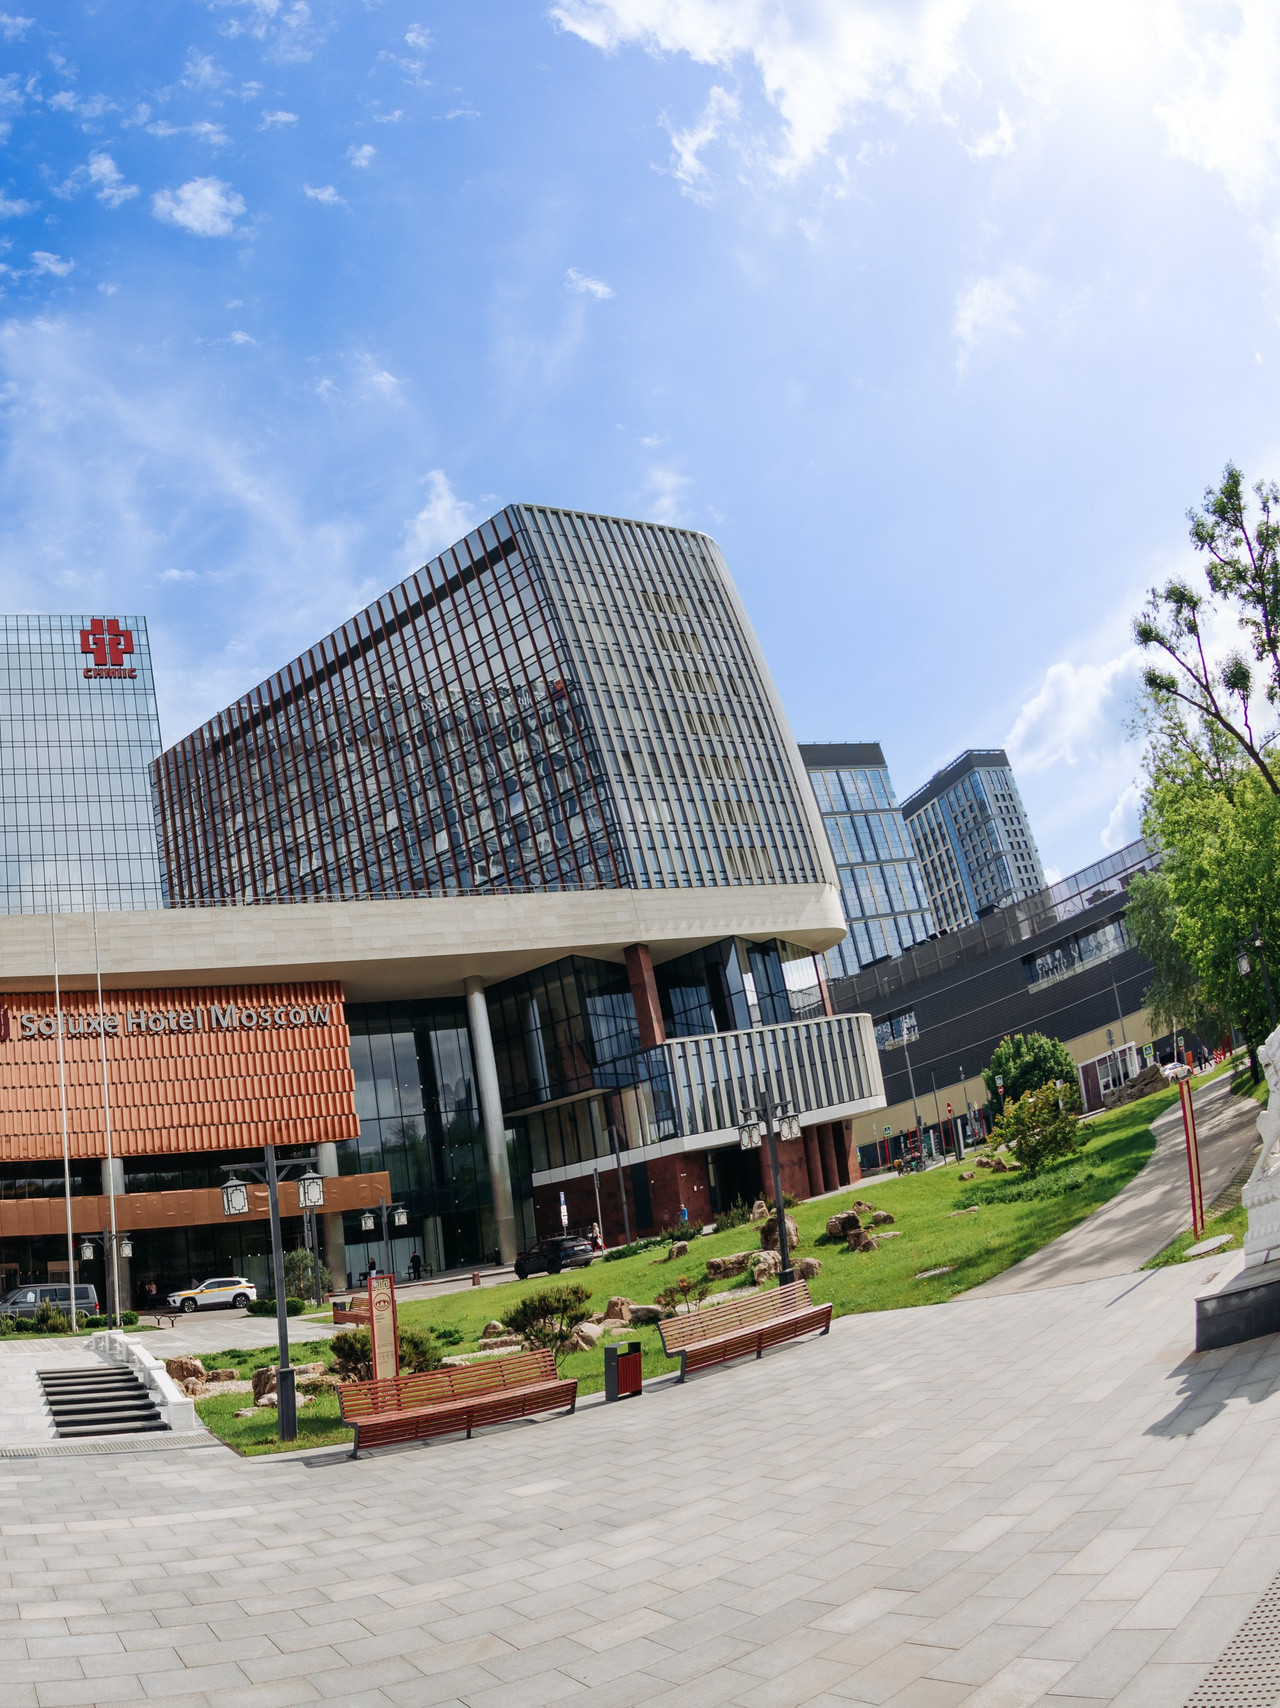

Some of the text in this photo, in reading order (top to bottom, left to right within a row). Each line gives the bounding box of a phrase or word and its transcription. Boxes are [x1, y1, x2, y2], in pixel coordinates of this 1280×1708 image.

[83, 668, 137, 679] CHMIIC
[21, 1004, 331, 1036] Soluxe Hotel Moscow
